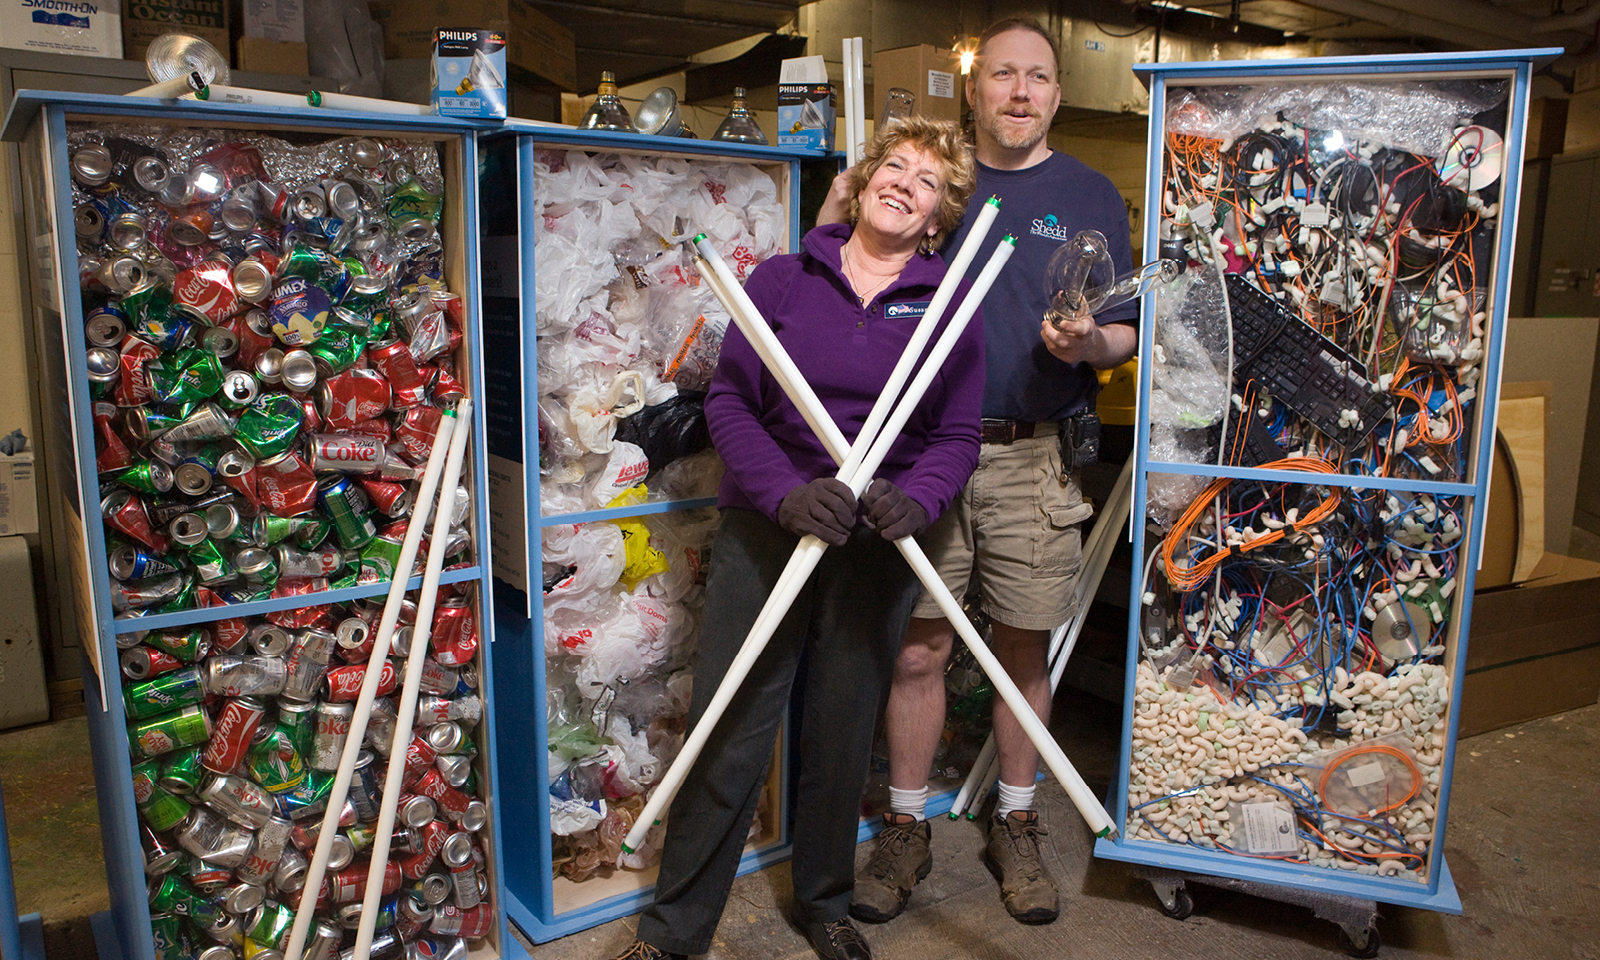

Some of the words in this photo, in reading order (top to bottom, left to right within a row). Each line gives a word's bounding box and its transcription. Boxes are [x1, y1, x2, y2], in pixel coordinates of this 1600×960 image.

[133, 4, 217, 28] Ocean
[439, 30, 478, 42] PHILIPS
[779, 85, 808, 94] PHILIPS
[1031, 218, 1067, 239] Shedd
[322, 441, 375, 463] Coke
[356, 440, 375, 448] Diet
[288, 644, 304, 676] Coke
